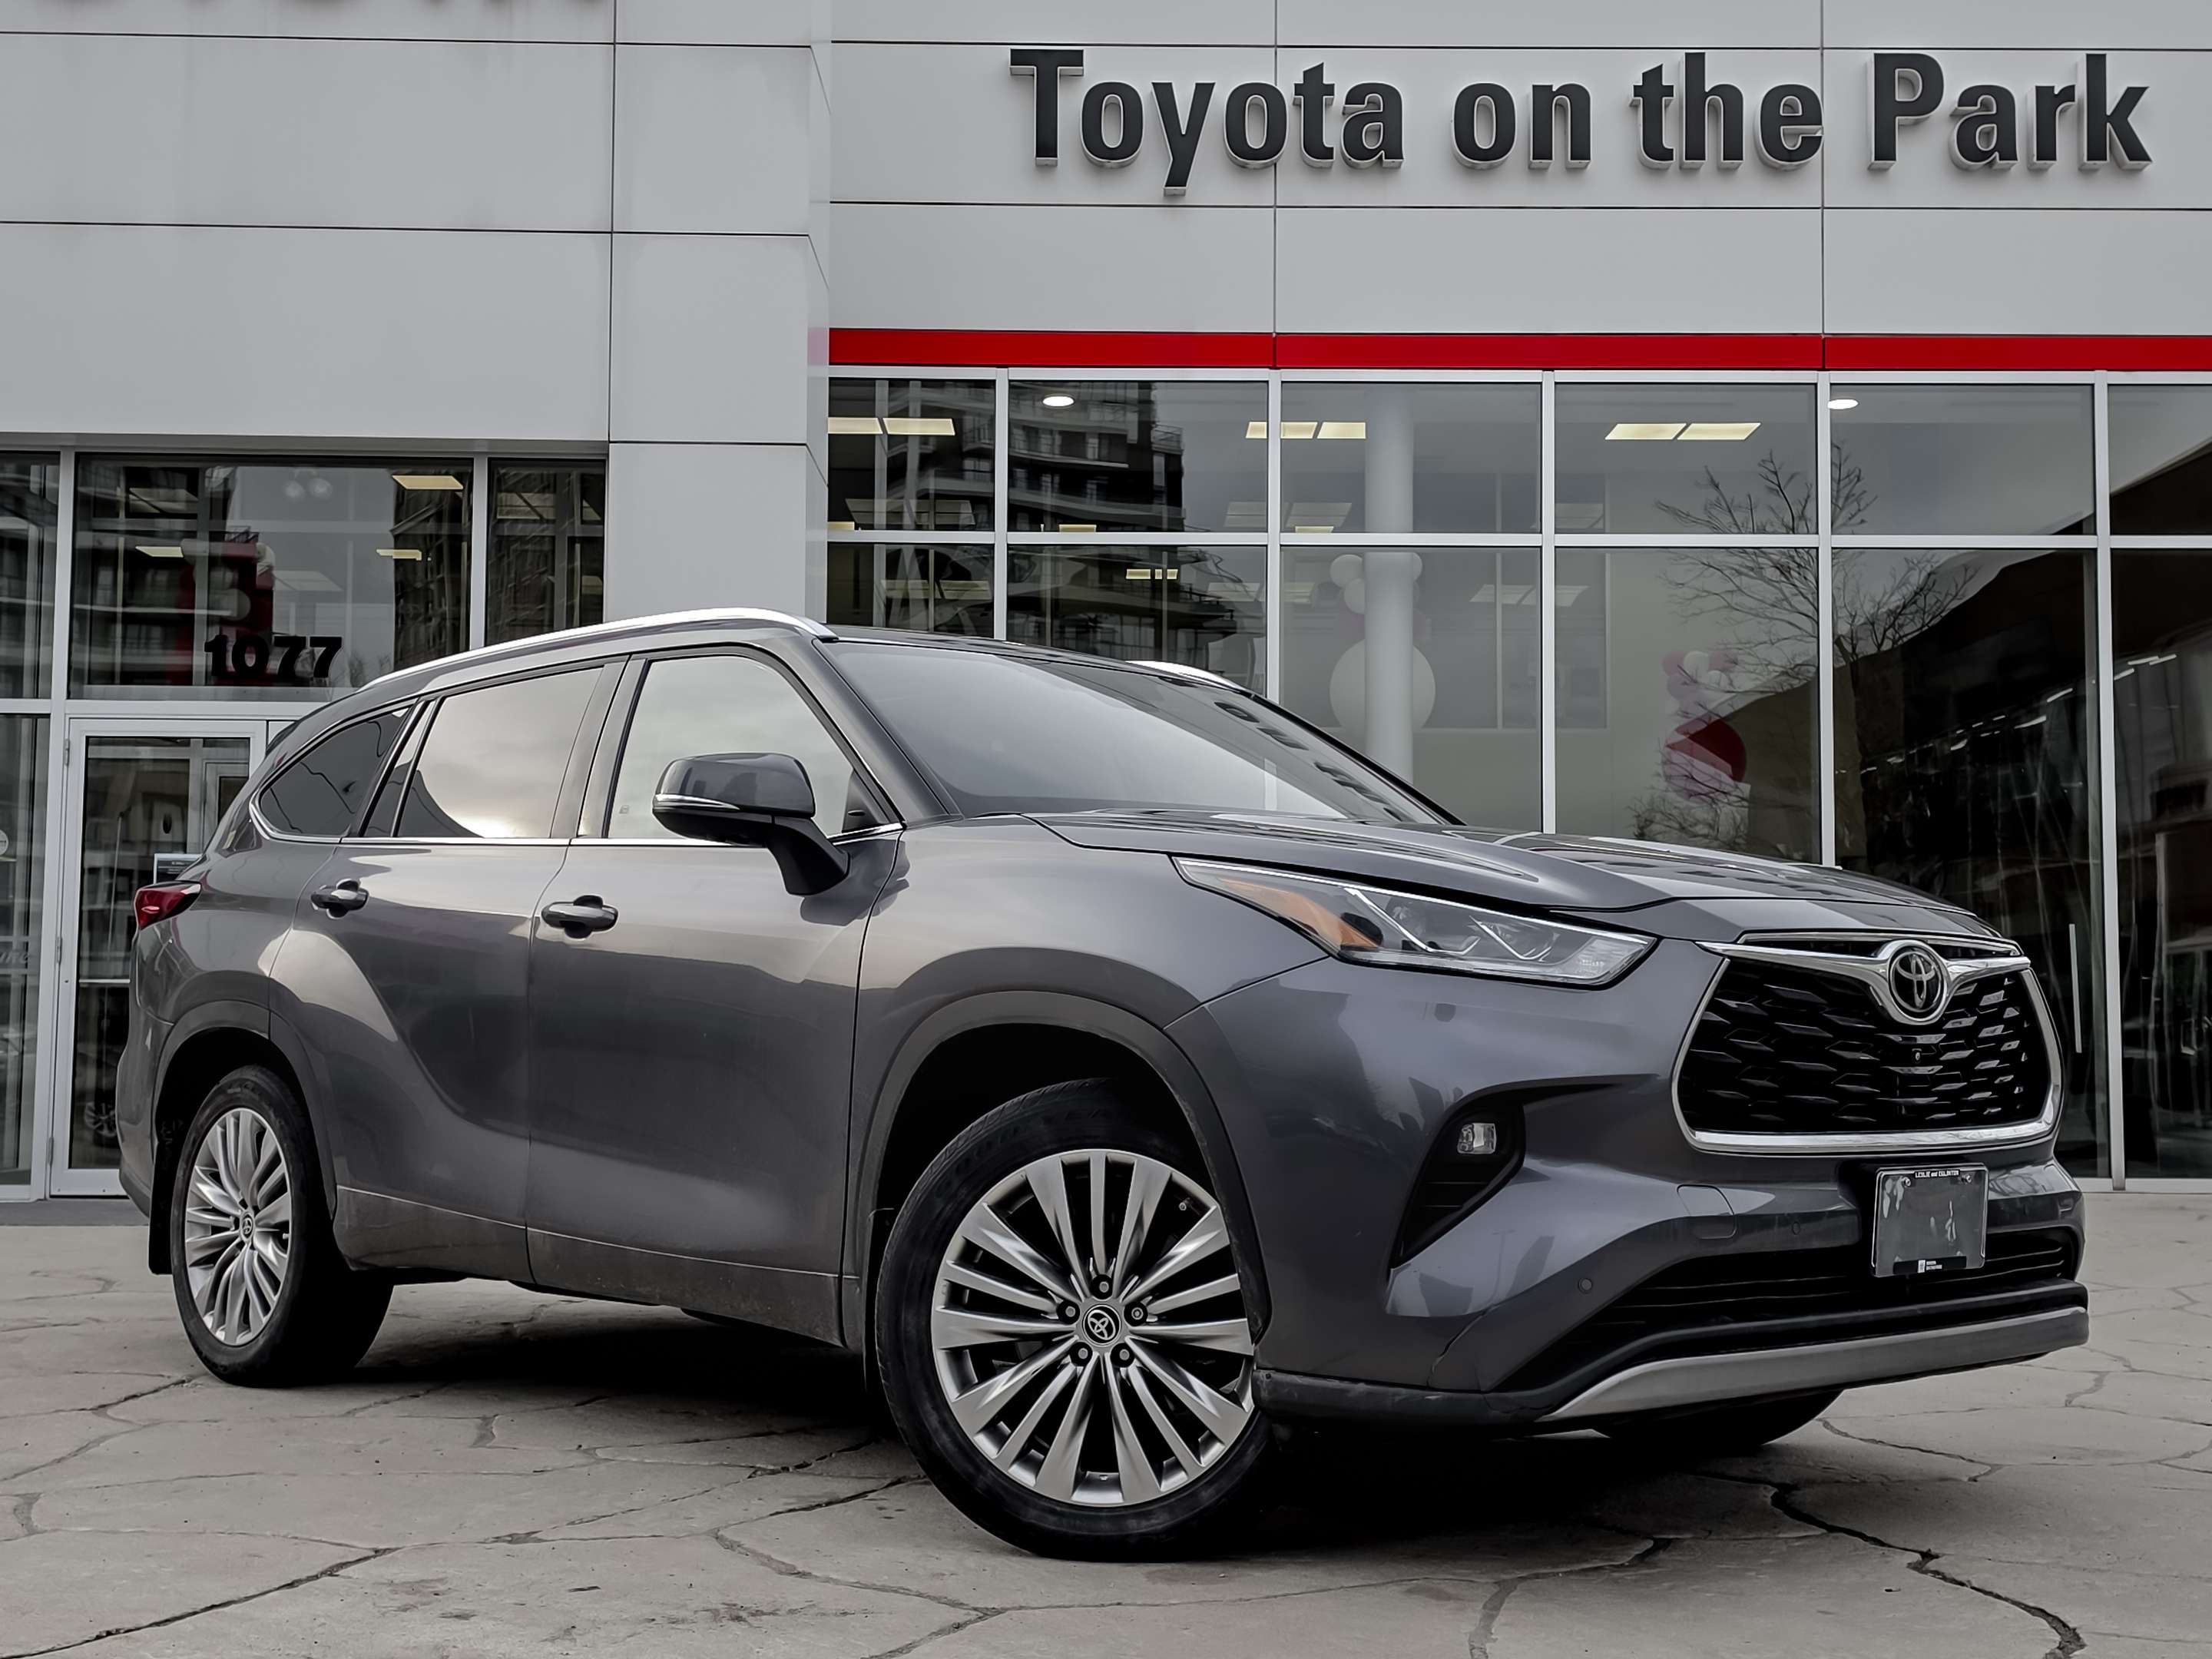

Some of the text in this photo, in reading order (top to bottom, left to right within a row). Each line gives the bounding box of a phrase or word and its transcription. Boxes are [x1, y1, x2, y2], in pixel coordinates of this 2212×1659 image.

[1009, 48, 2152, 194] Toyota on the Park
[204, 634, 343, 678] 1077
